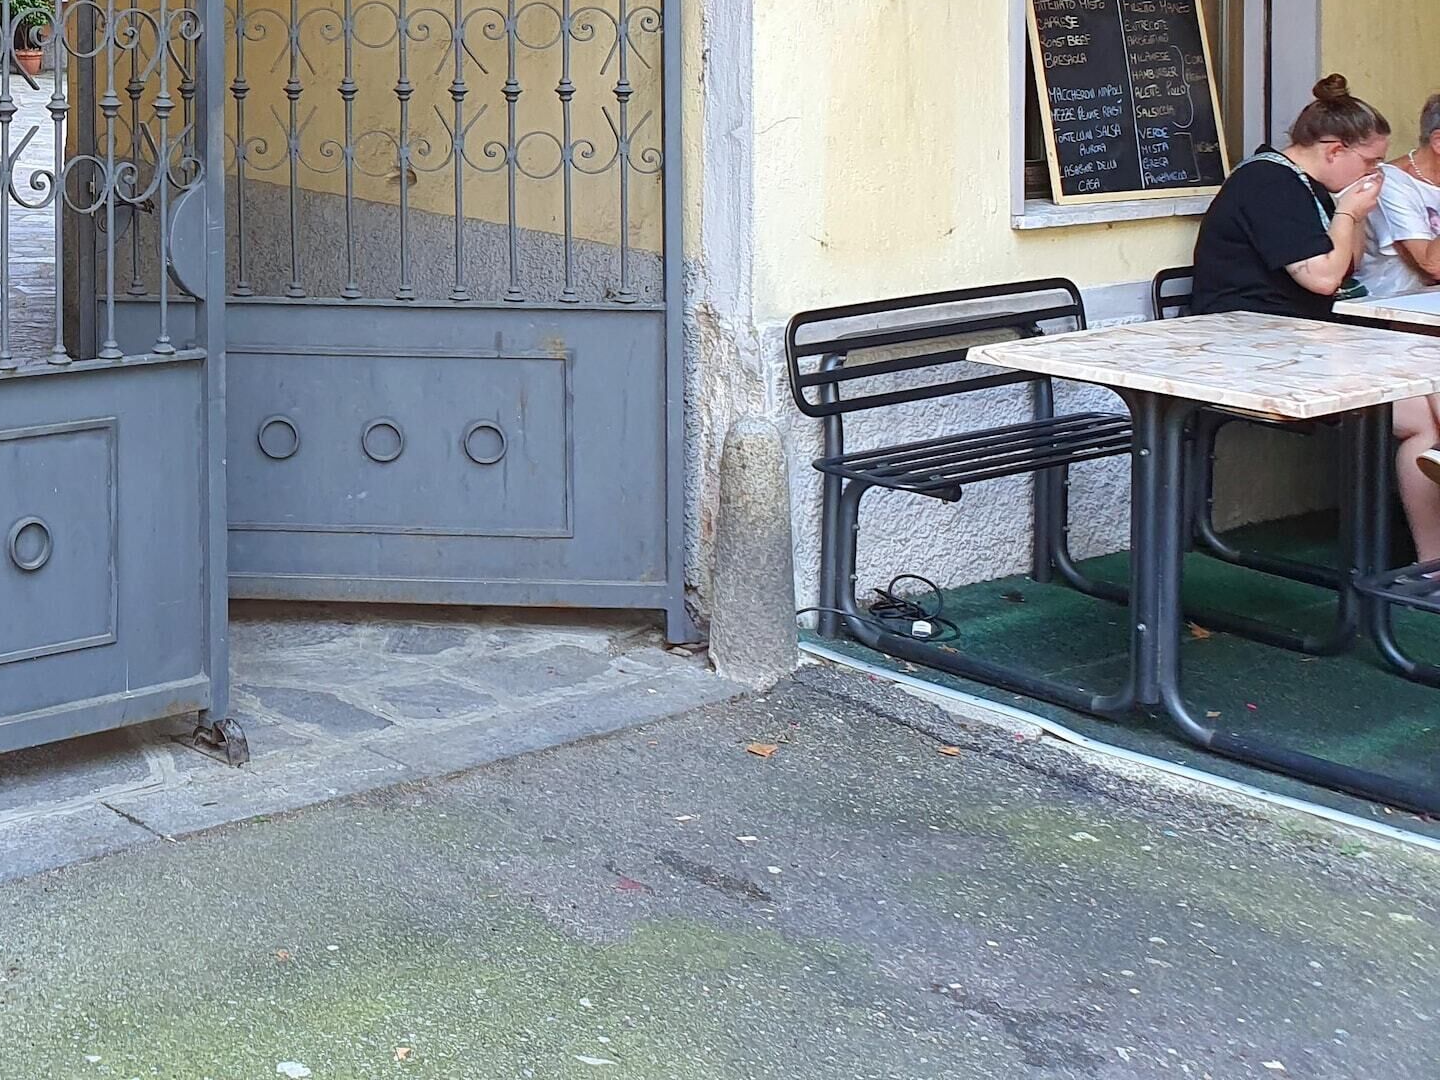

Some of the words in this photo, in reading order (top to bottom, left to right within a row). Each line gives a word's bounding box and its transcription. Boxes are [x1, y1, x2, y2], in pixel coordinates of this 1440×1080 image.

[1095, 123, 1122, 138] SALSA
[1141, 142, 1169, 155] MISTA
[1078, 178, 1101, 192] CASA
